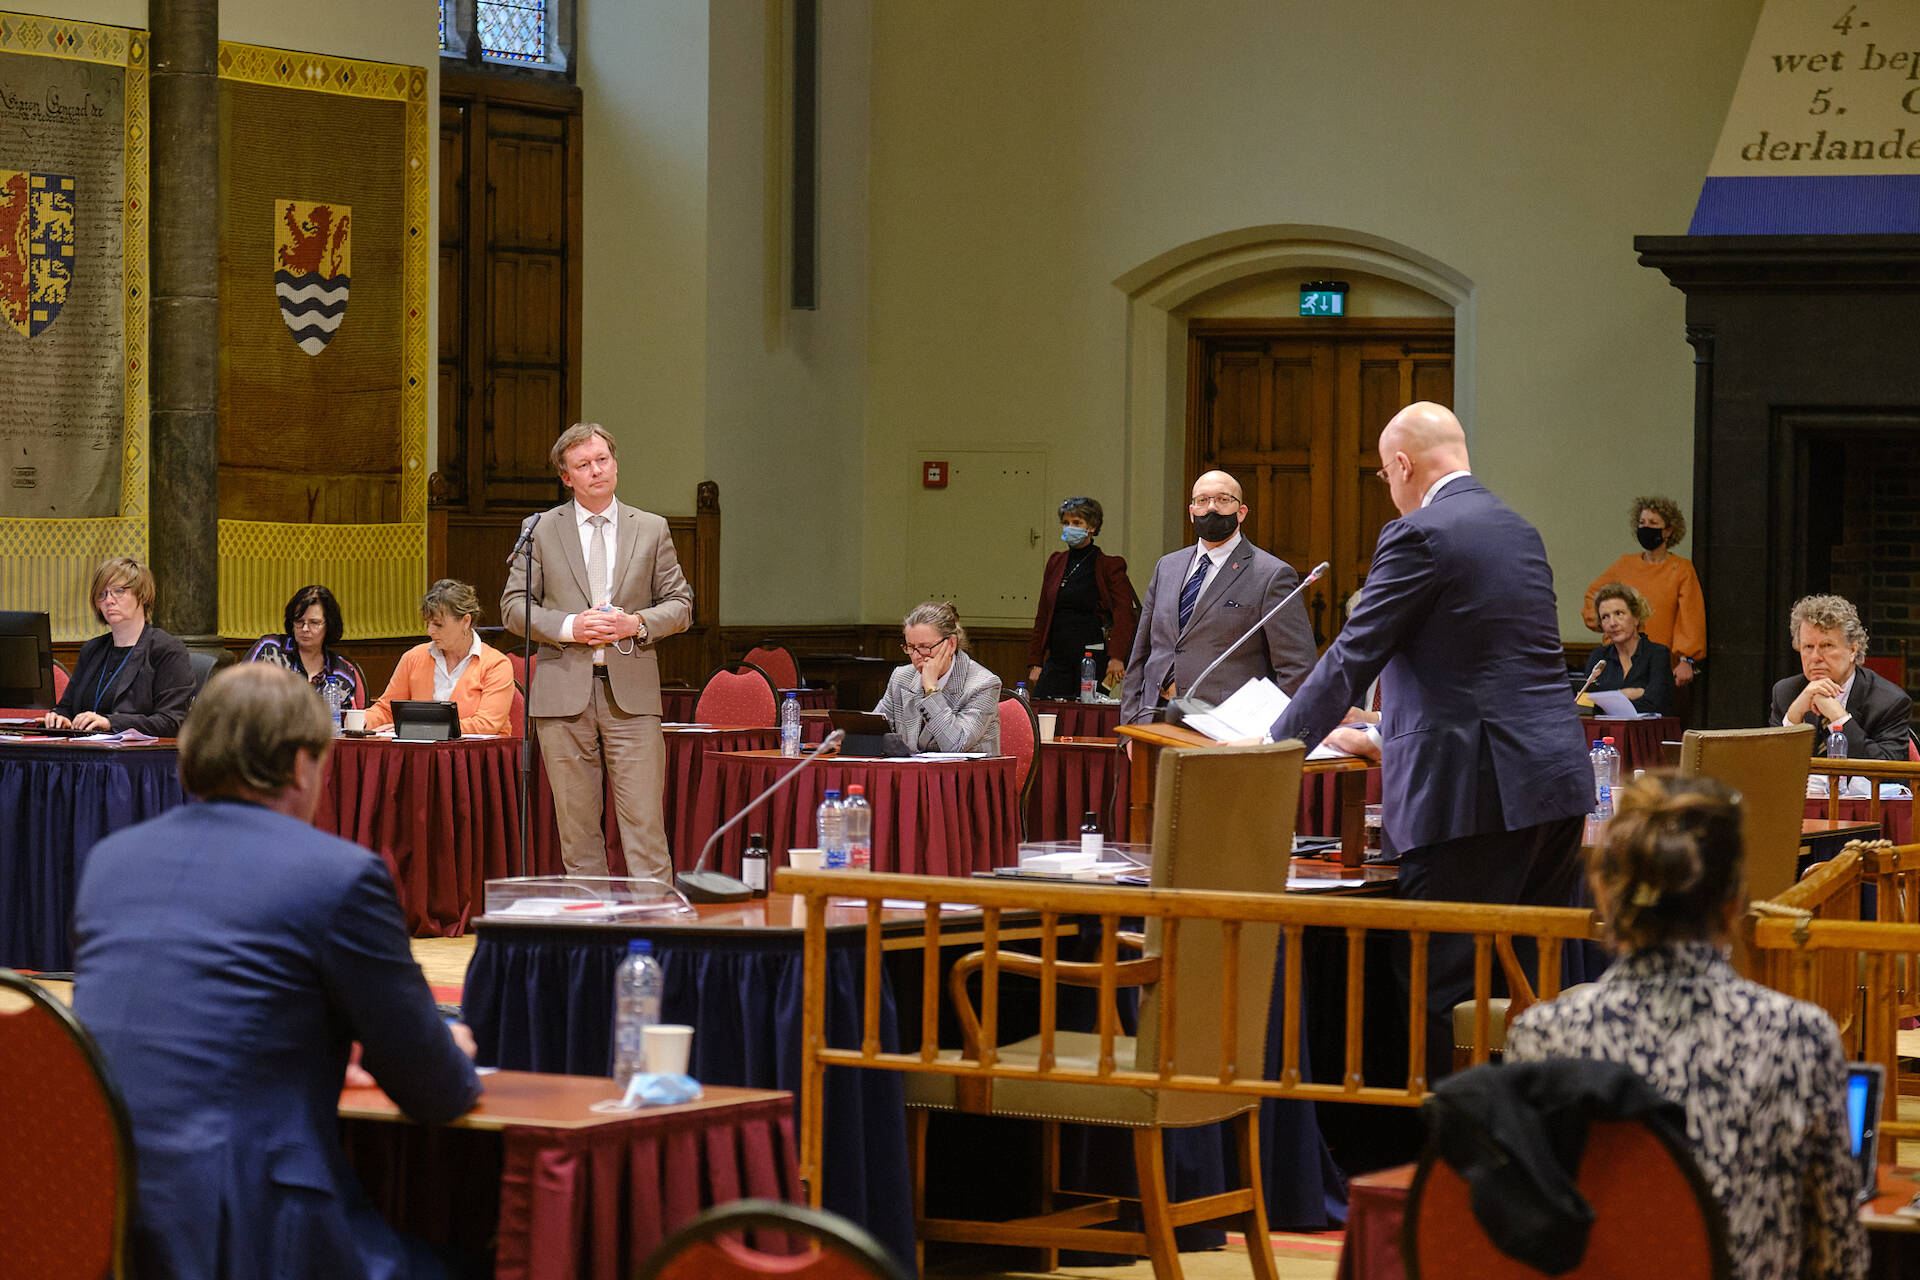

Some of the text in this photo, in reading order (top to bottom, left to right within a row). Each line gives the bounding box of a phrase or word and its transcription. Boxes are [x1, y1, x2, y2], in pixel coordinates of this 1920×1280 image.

[1832, 4, 1870, 35] 4.
[1771, 50, 1845, 73] wet
[1808, 87, 1847, 115] 5.
[1741, 128, 1920, 161] derlande
